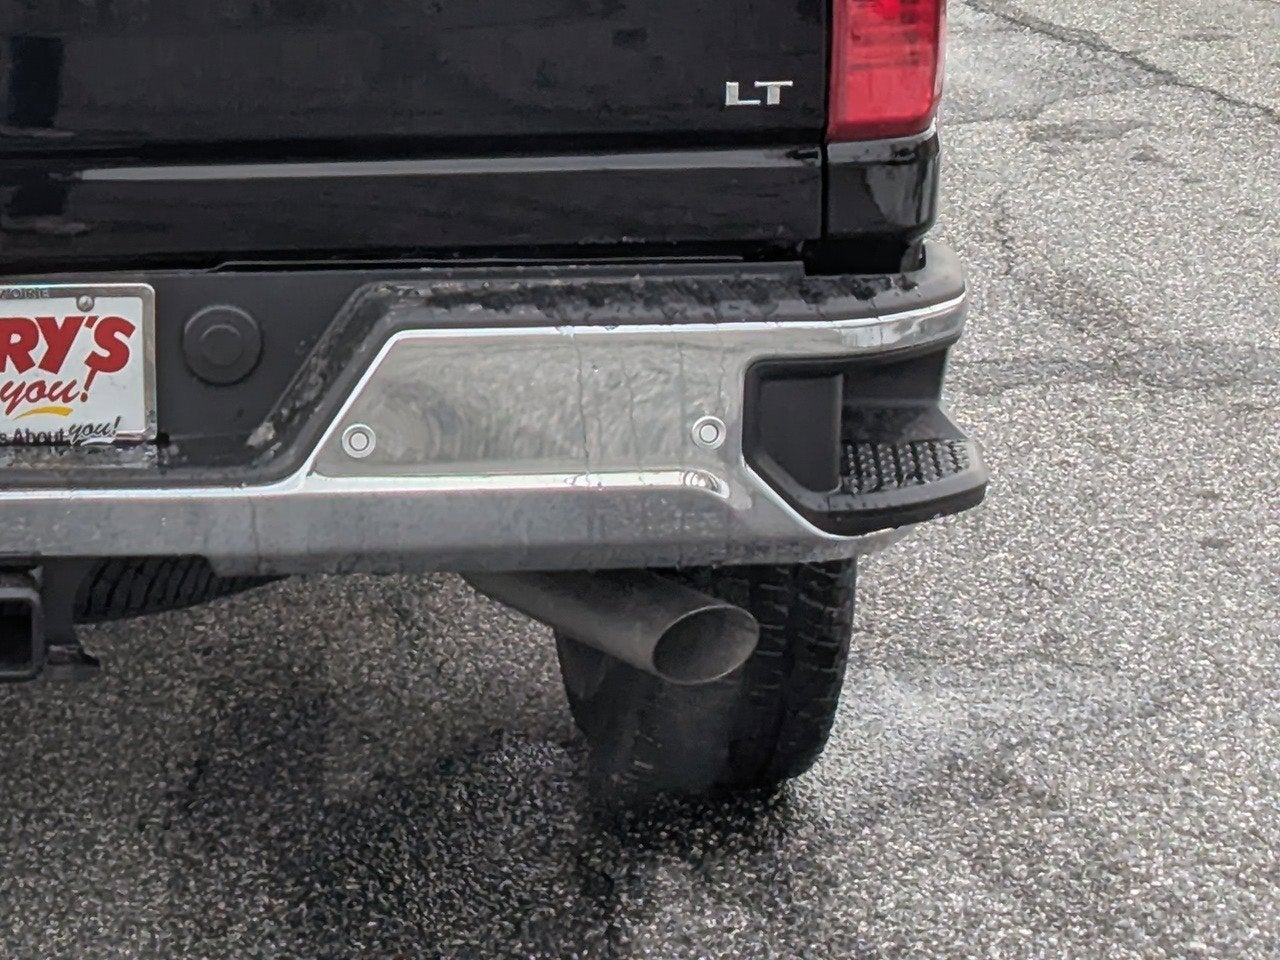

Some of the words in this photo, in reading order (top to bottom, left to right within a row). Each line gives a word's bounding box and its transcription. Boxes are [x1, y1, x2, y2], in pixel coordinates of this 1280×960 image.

[725, 81, 793, 106] LT
[0, 370, 99, 416] you!
[13, 428, 65, 445] About
[69, 416, 122, 446] you!
